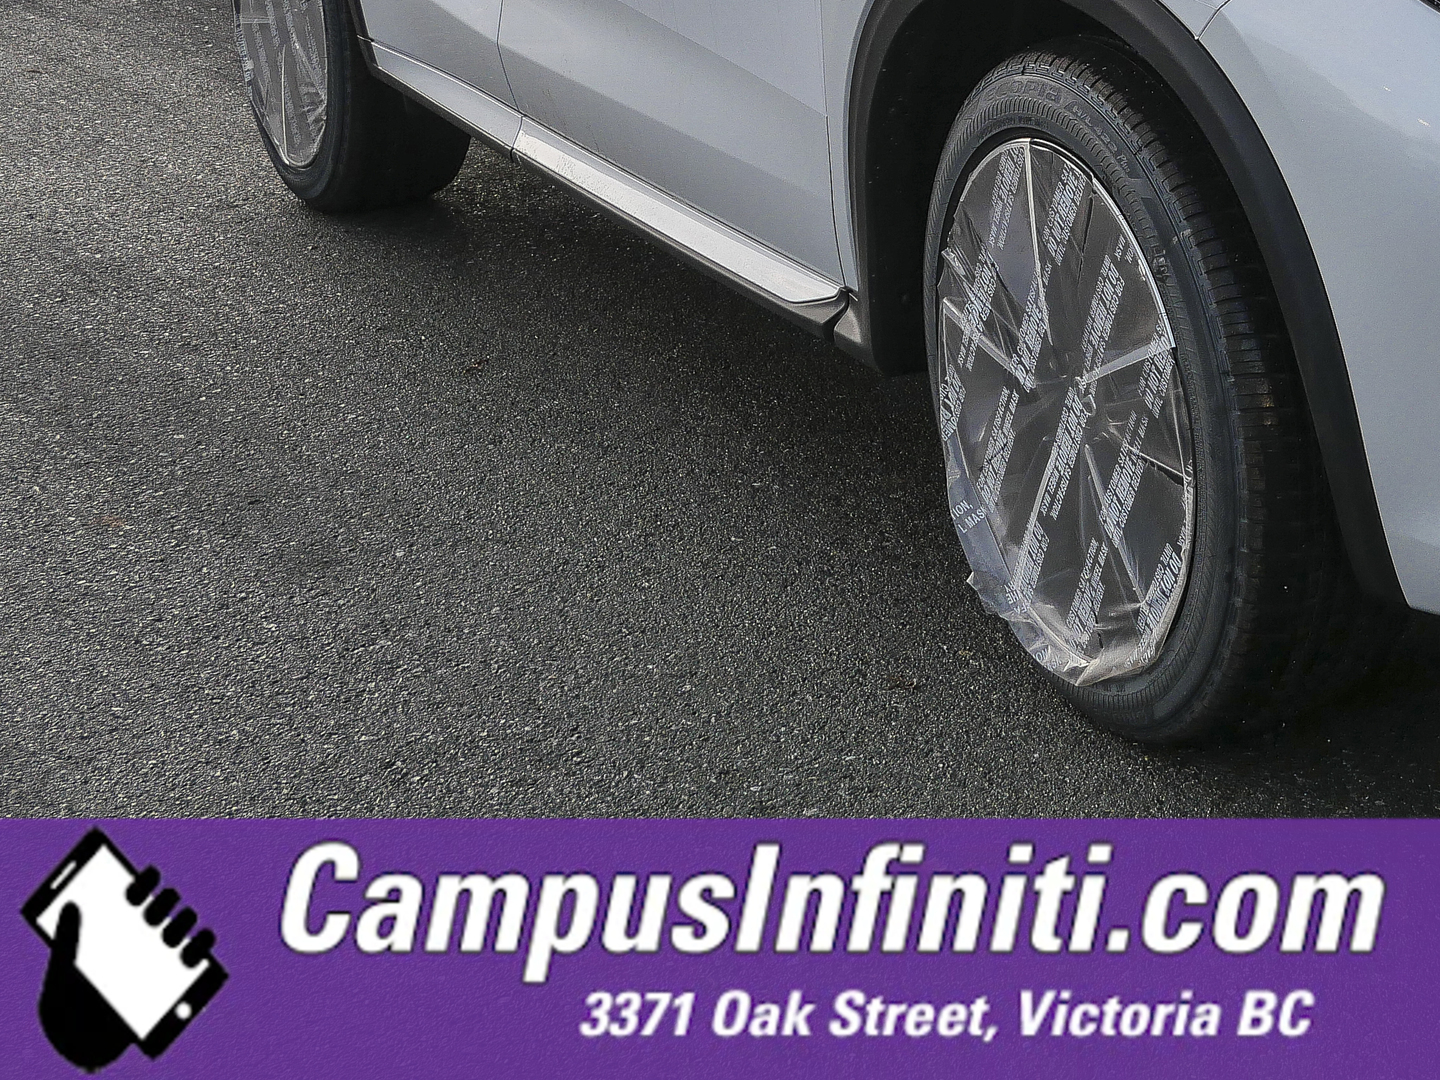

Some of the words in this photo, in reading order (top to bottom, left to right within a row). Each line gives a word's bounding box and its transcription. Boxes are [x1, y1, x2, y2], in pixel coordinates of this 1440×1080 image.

[998, 156, 1015, 202] REMOVE
[1046, 179, 1064, 227] CUSTOMER
[1057, 170, 1078, 219] REMOVE
[1051, 215, 1064, 241] NOT
[1054, 241, 1065, 266] UNTIL
[1060, 201, 1077, 244] CUSTOMER
[1046, 236, 1057, 255] DO
[1100, 253, 1111, 277] UNTIL
[1107, 264, 1119, 285] DO
[1088, 276, 1104, 317] CUSTOMER
[1100, 280, 1114, 306] NOT
[1114, 275, 1125, 296] FOR
[1025, 304, 1042, 348] REMOVE
[1088, 302, 1107, 348] REMOVE
[1101, 294, 1119, 341] CUSTOMER
[1147, 366, 1161, 393] NOT
[1008, 388, 1019, 412] MASK
[1071, 396, 1082, 415] DO
[1065, 411, 1078, 435] NOT
[1078, 408, 1088, 427] FOR
[1055, 432, 1072, 474] REMOVE
[1067, 424, 1083, 468] CUSTOMER
[985, 466, 996, 488] NOT
[1046, 466, 1059, 497] WHEEL
[1115, 456, 1135, 501] REMOVE
[980, 484, 991, 502] DO
[1040, 492, 1051, 516] MASK
[1049, 464, 1071, 523] SATISFACTION,
[1107, 496, 1121, 523] NOT
[1118, 486, 1135, 529] CUSTOMER
[1033, 521, 1043, 539] DO
[1104, 518, 1115, 537] DO
[1027, 535, 1039, 557] NOT
[1029, 548, 1044, 587] CUSTOMER
[1168, 552, 1181, 573] DO
[1077, 582, 1095, 623] REMOVE
[1097, 542, 1108, 565] MASK
[1066, 587, 1082, 629] CUSTOMER
